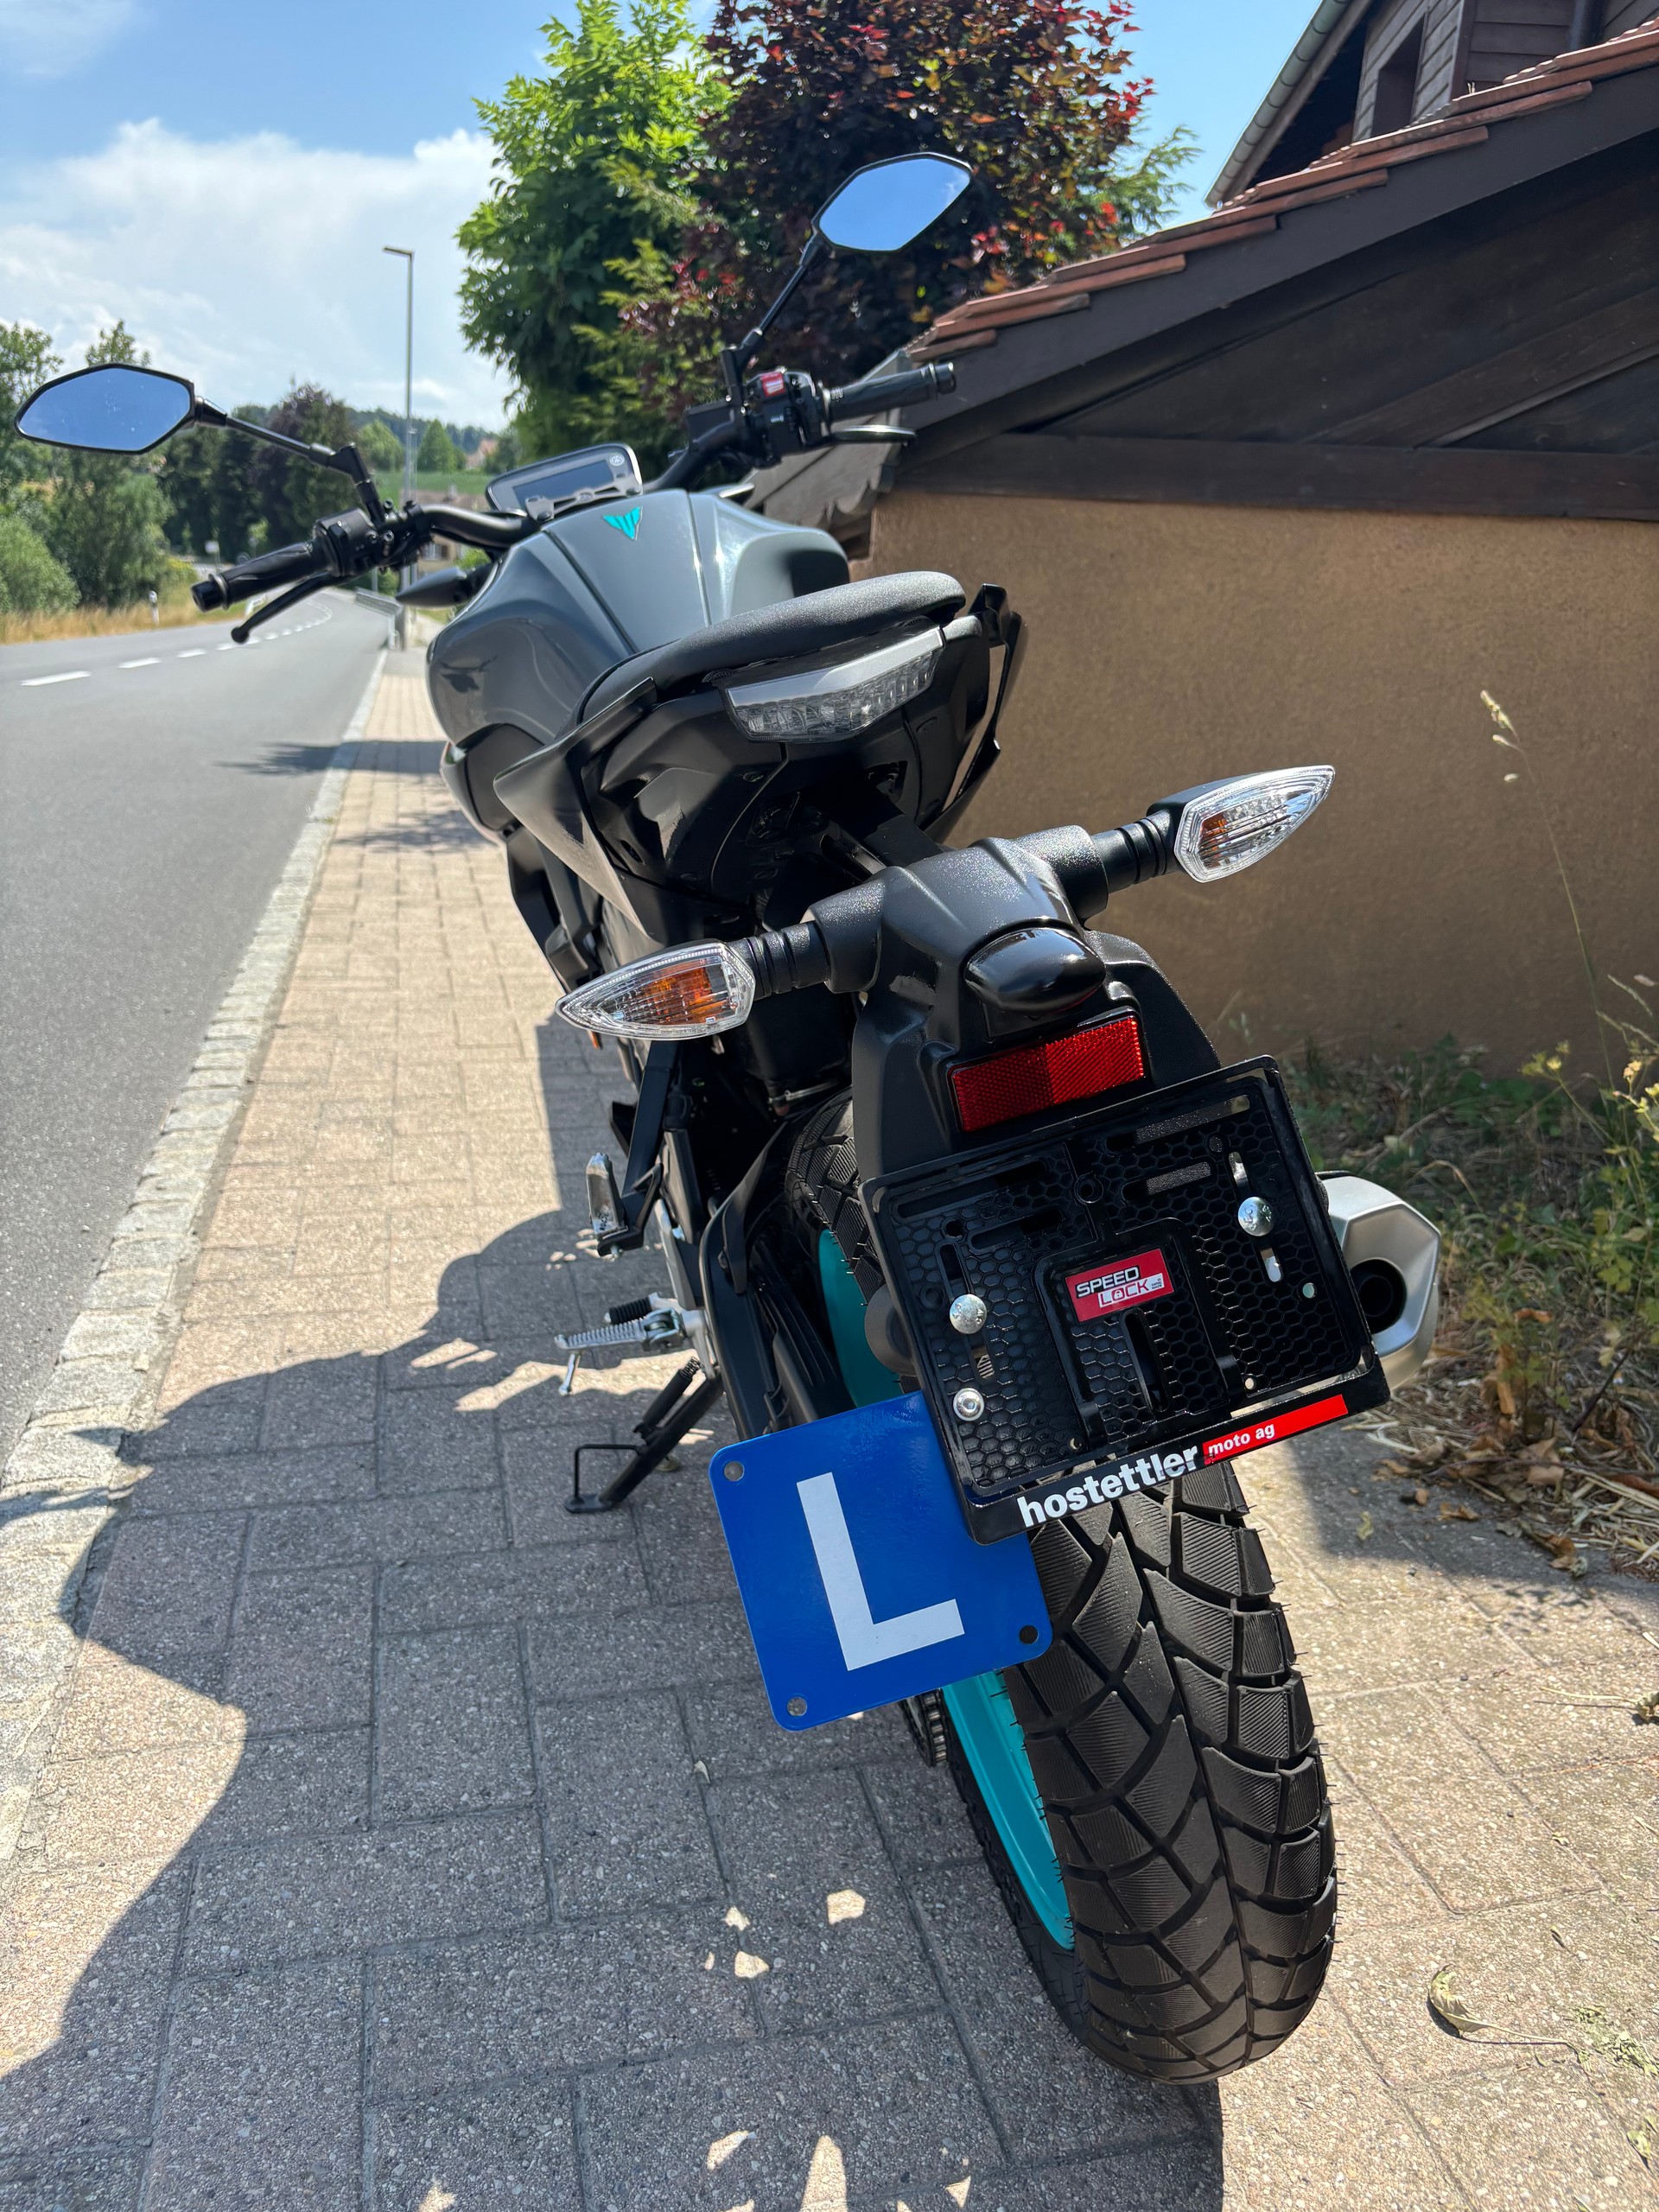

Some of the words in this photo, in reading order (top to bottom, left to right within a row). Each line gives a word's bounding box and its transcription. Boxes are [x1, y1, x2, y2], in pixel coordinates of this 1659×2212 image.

[1077, 1266, 1140, 1297] SPEED
[1100, 1279, 1149, 1306] LOCK
[1016, 1445, 1198, 1528] hostettler
[1208, 1431, 1251, 1456] moto
[1255, 1424, 1275, 1440] ag
[796, 1472, 965, 1671] L
